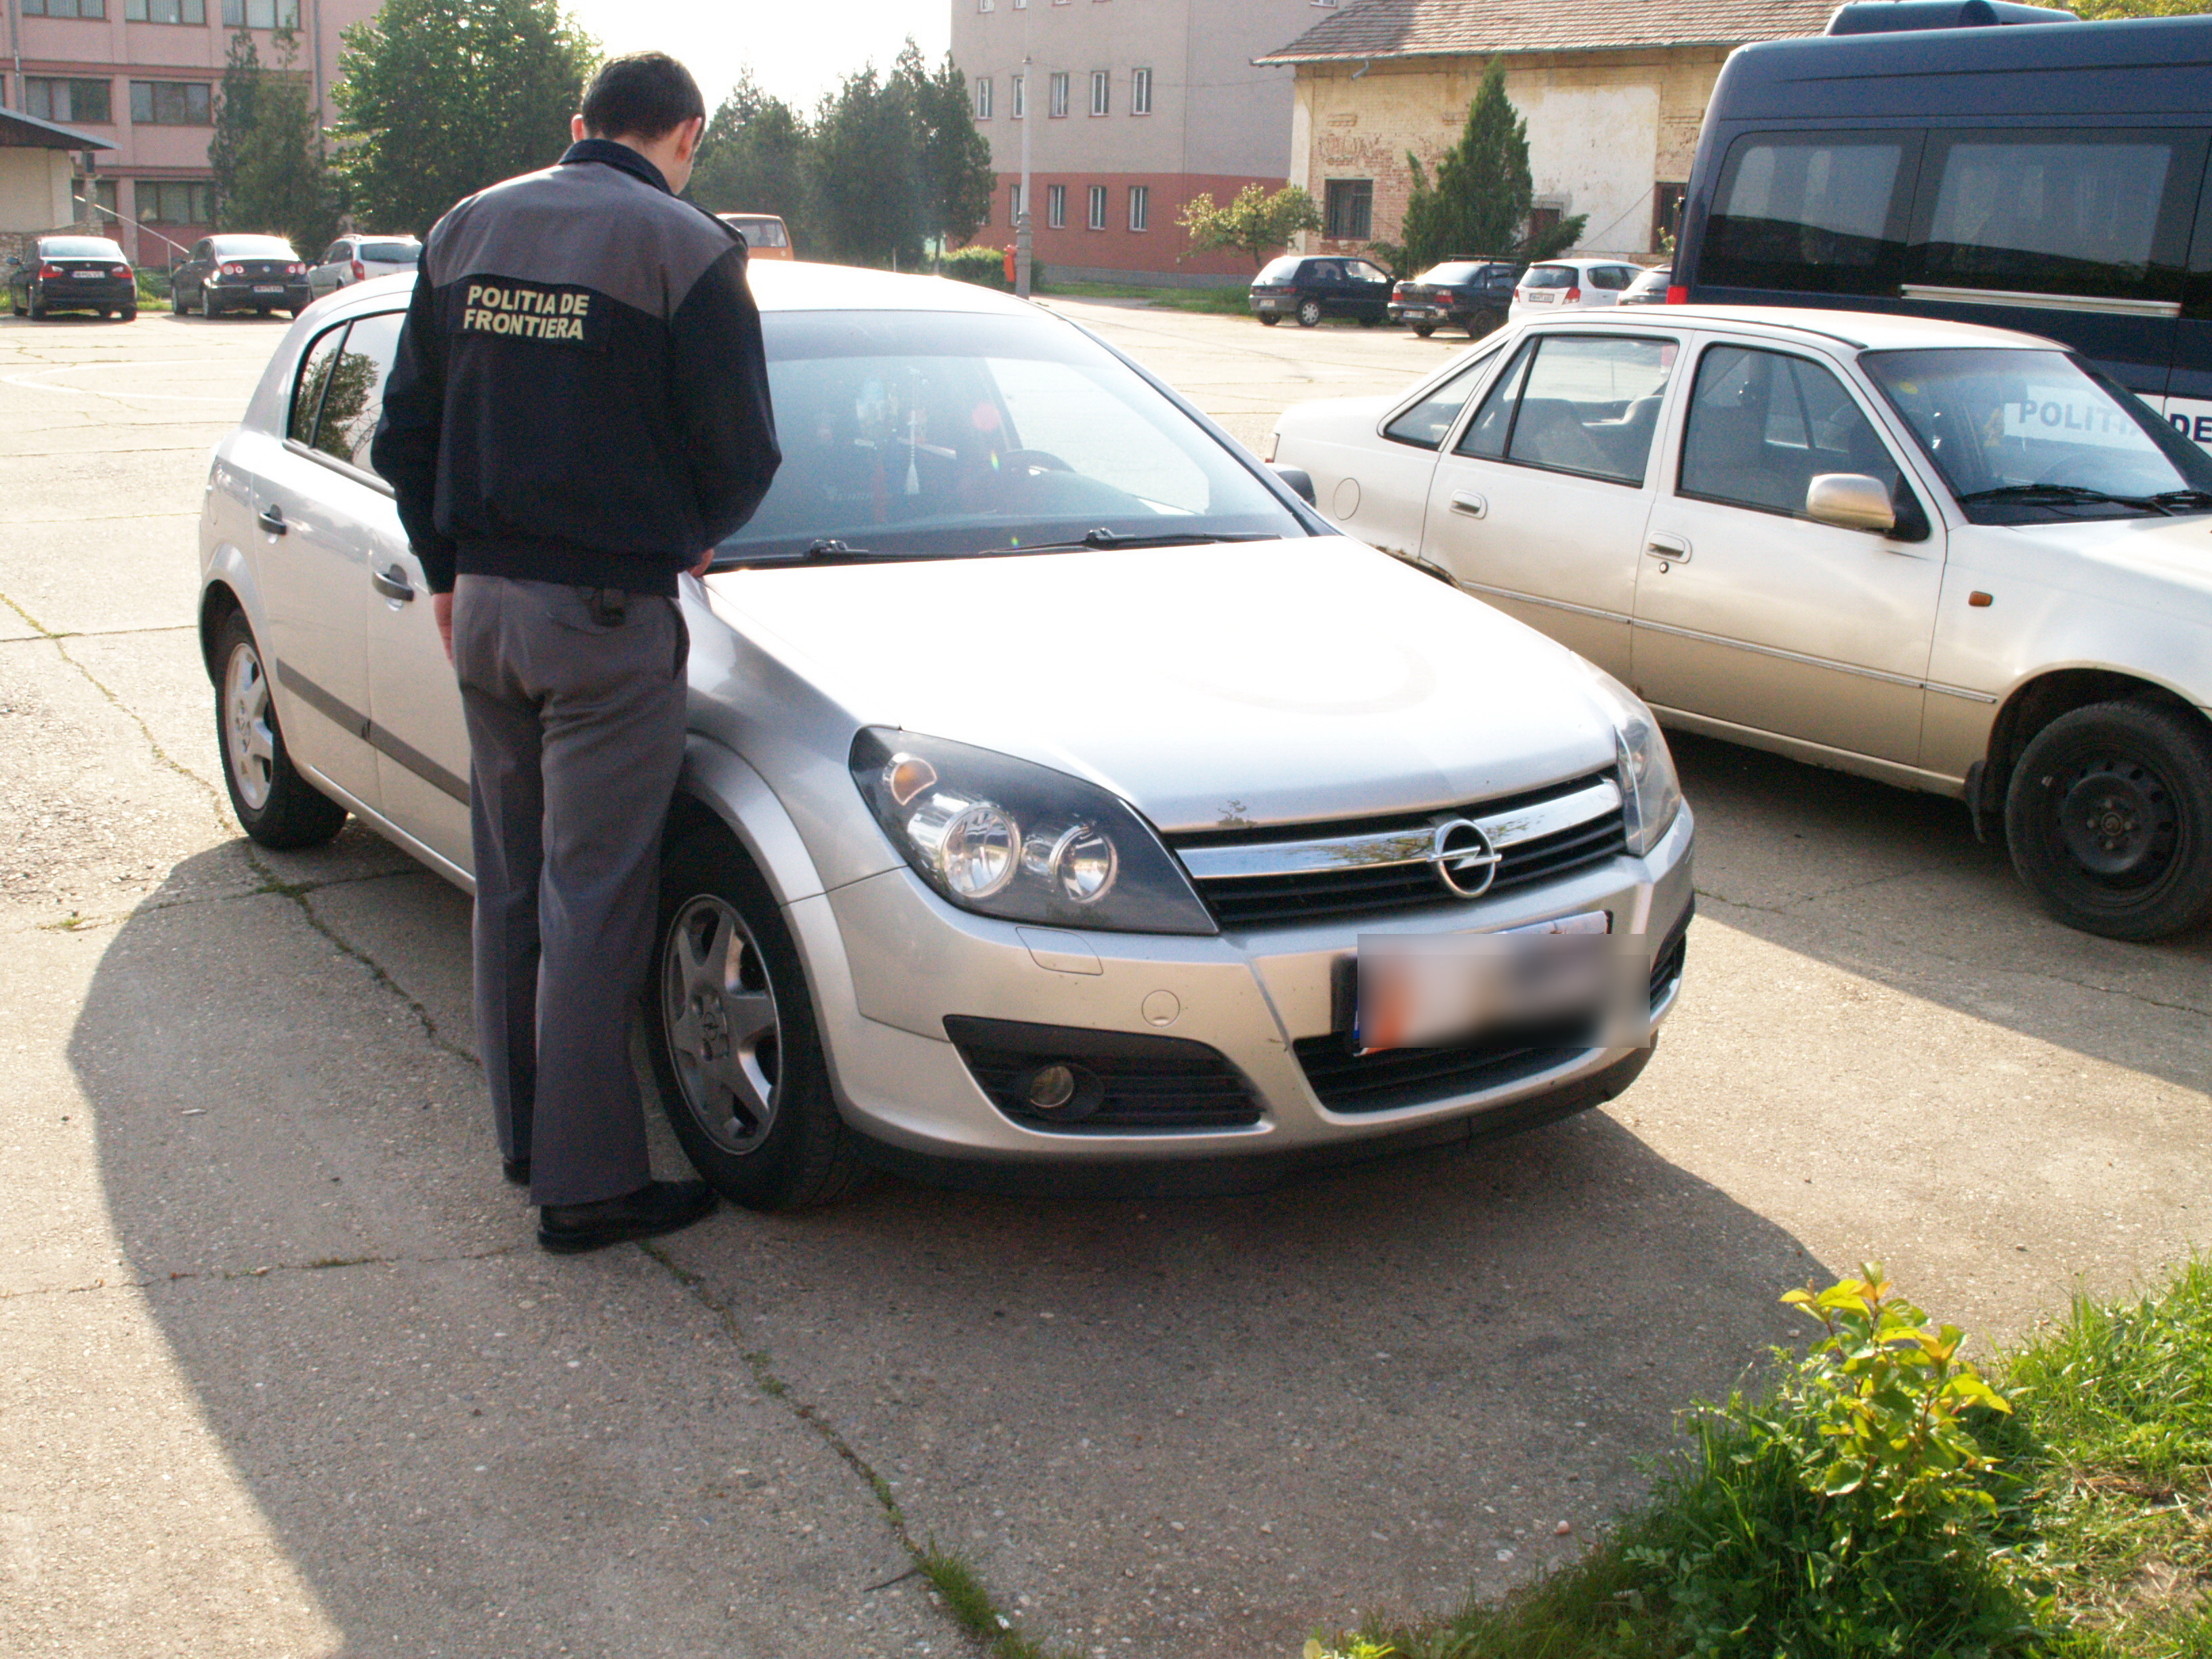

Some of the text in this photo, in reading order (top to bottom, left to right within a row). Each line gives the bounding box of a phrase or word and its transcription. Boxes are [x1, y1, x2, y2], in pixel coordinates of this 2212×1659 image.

[467, 285, 590, 316] POLITIA DE
[464, 308, 583, 340] FRONTIERA
